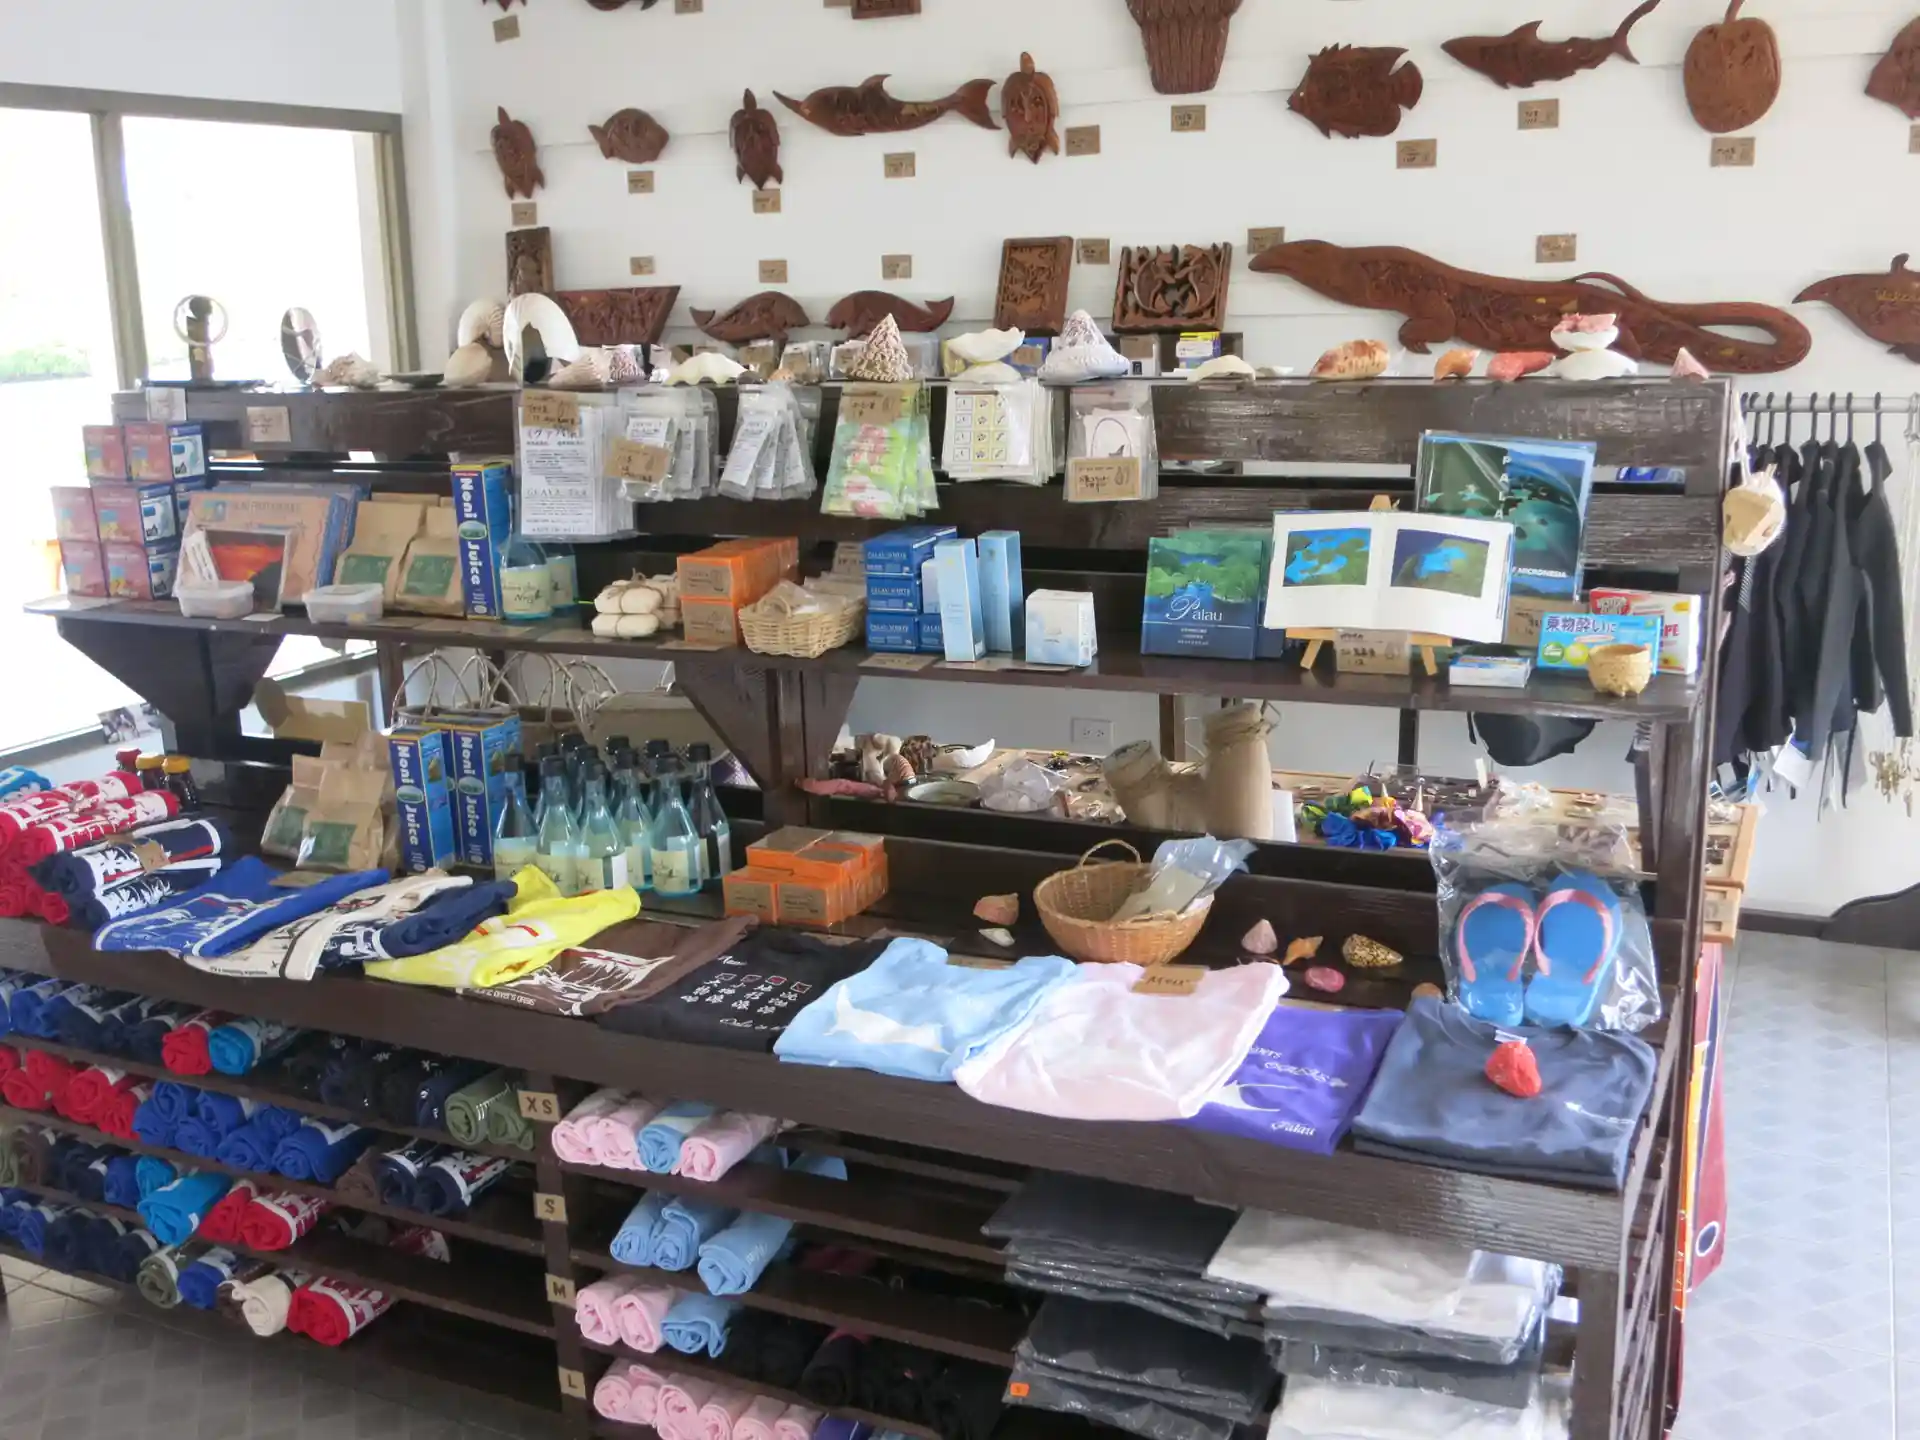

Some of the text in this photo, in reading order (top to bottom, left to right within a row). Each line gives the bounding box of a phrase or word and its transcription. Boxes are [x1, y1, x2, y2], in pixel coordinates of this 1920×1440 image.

[460, 478, 478, 518] Noni
[1494, 455, 1512, 520] PALA
[467, 541, 483, 585] Juice
[1518, 567, 1568, 579] MICRONESIA
[1165, 595, 1223, 621] Palau
[1662, 623, 1680, 638] PE
[397, 745, 414, 784] Noni
[461, 736, 476, 775] Noni
[405, 804, 420, 846] Juice
[466, 796, 480, 838] Juice
[544, 1198, 555, 1214] S
[553, 1281, 566, 1294] M
[567, 1374, 577, 1389] L
